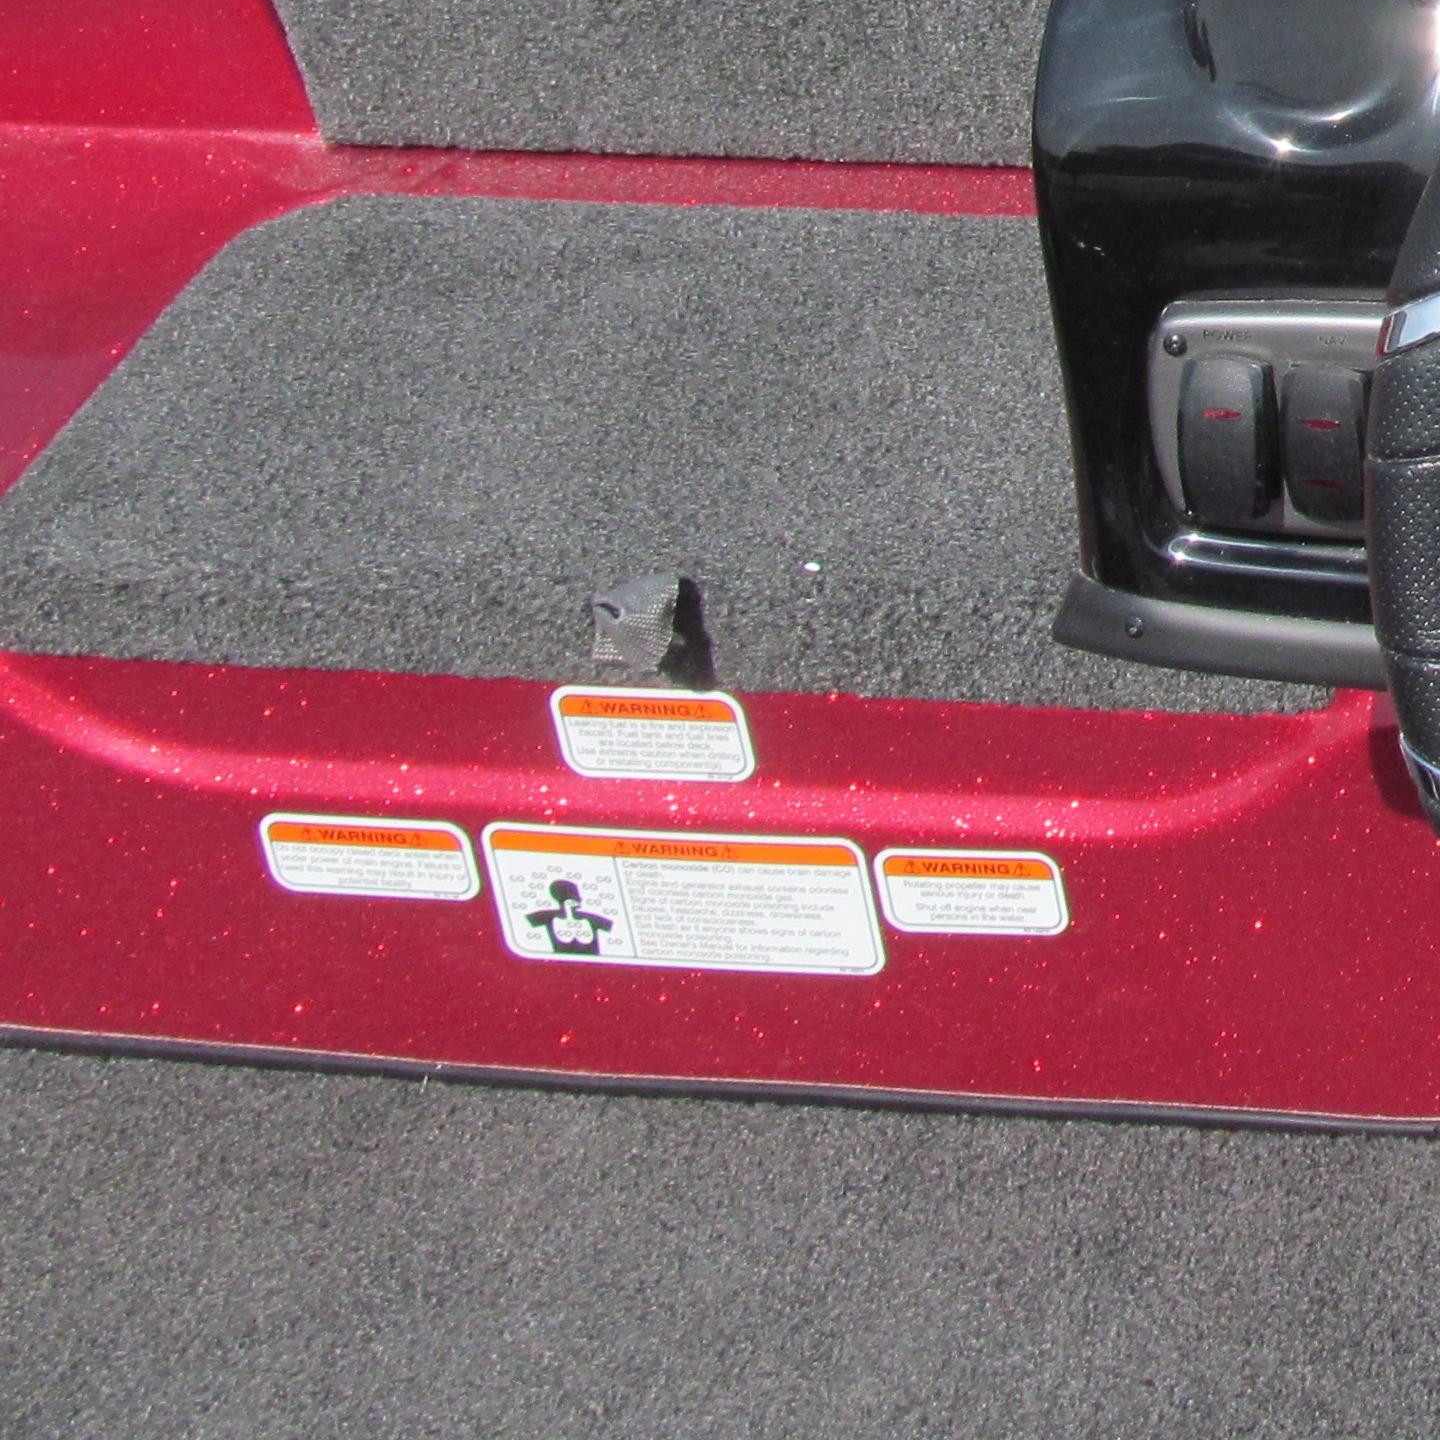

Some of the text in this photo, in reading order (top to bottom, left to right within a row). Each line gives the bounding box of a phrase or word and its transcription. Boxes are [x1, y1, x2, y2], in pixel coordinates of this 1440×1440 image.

[599, 702, 691, 717] WARNING
[317, 829, 406, 844] WARNING
[633, 844, 718, 857] WARNING
[923, 862, 1009, 874] WARNING
